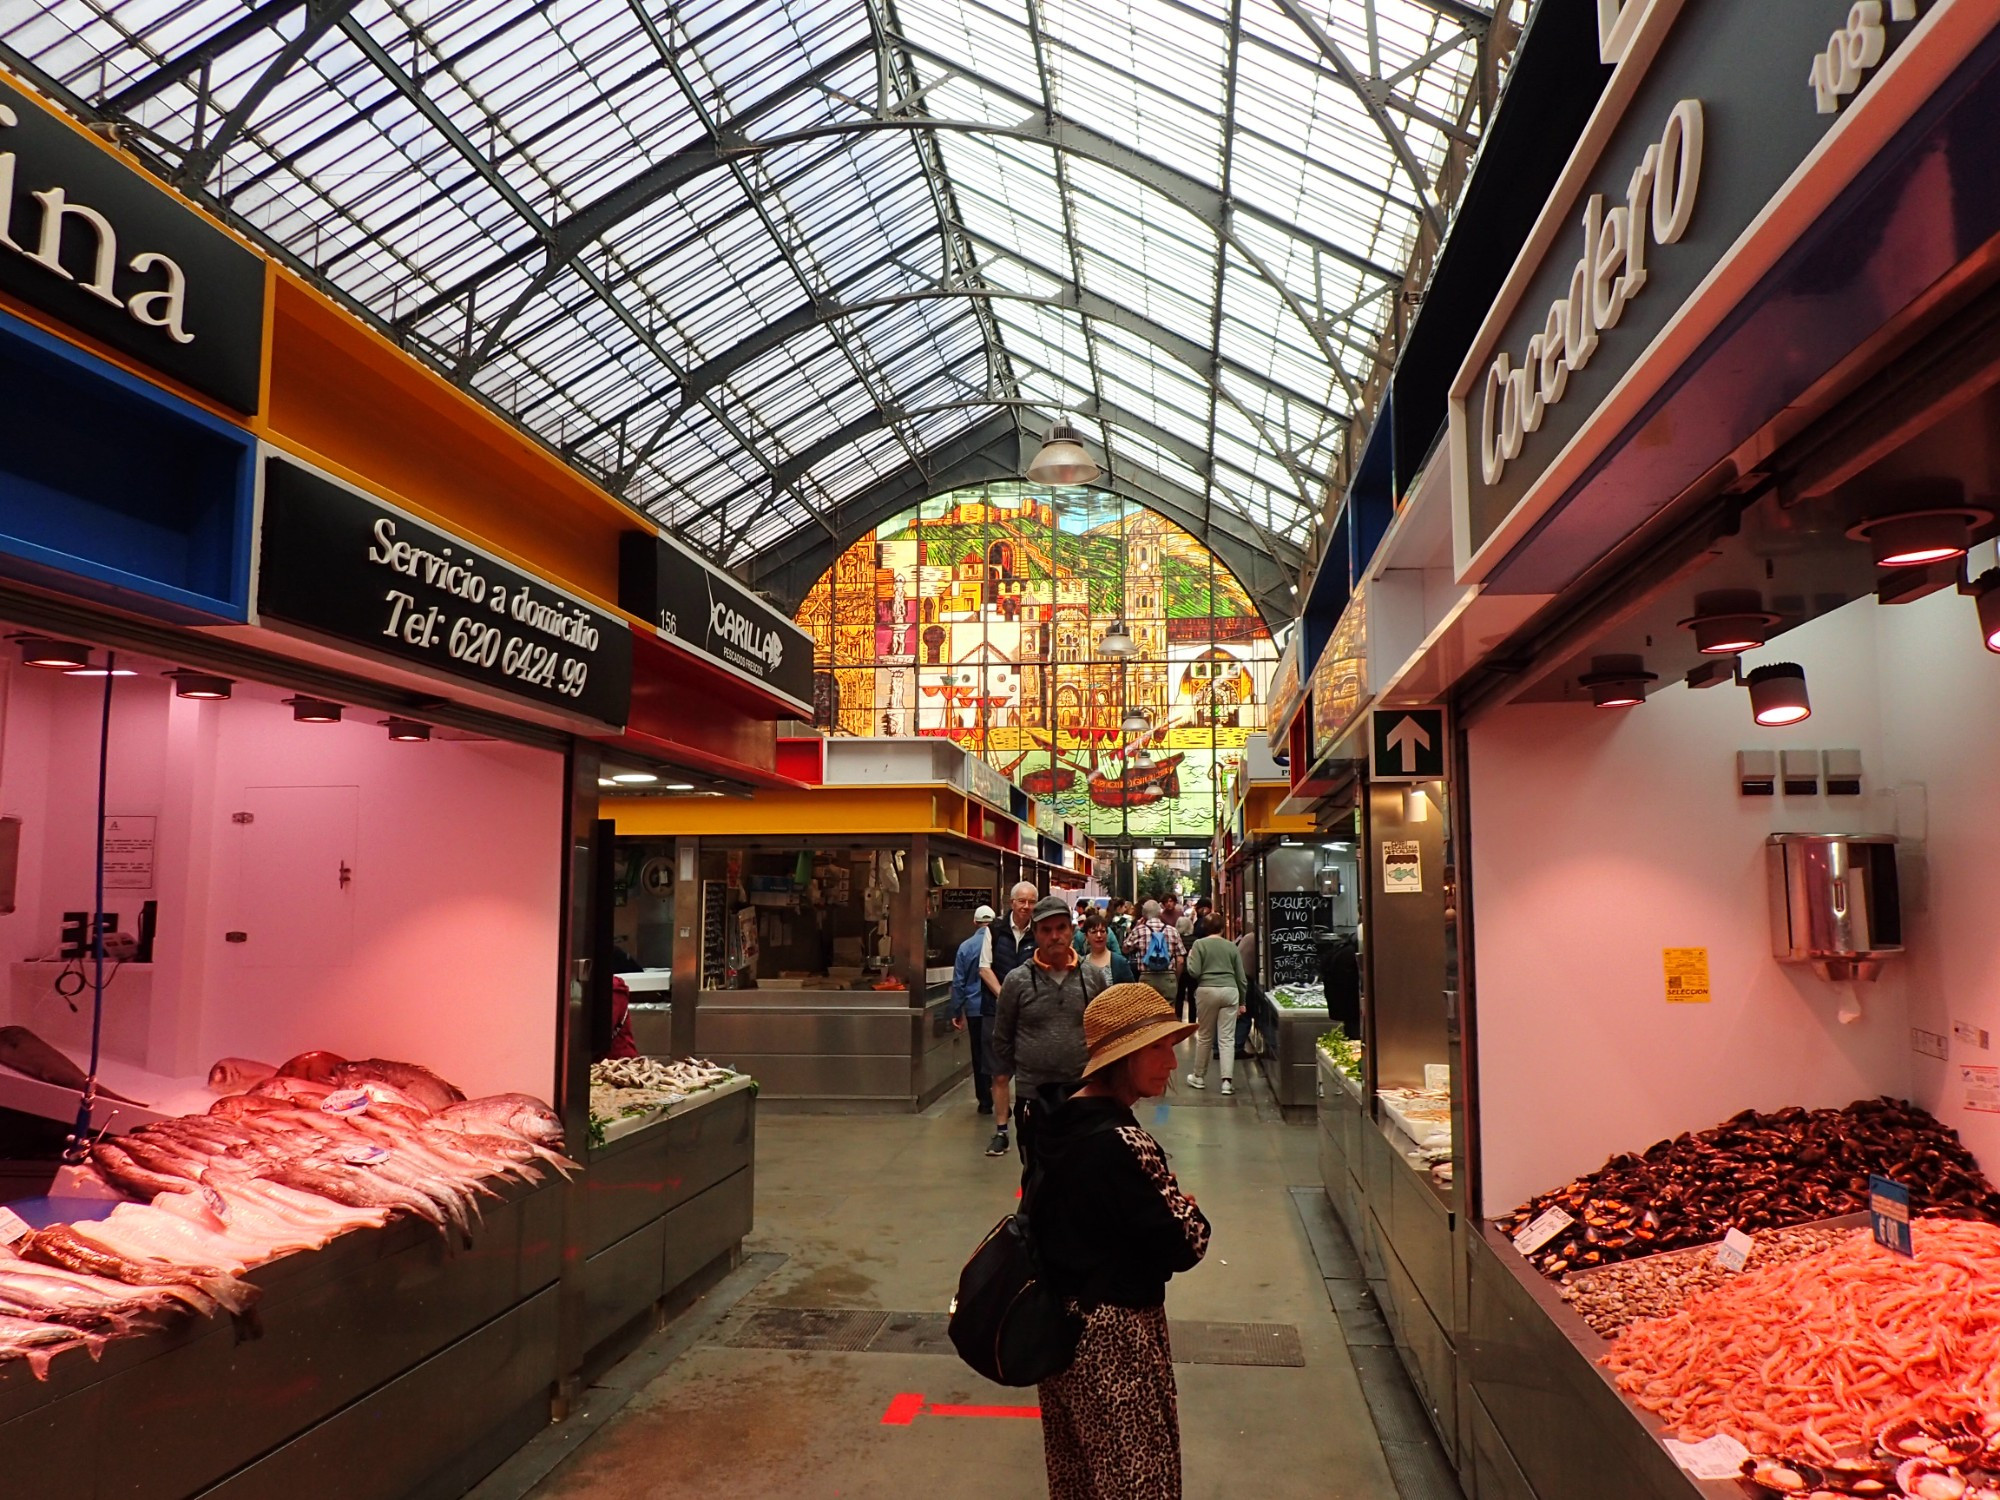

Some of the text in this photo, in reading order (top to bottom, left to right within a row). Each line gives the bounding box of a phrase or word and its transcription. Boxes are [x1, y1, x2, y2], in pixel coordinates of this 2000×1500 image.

[1482, 99, 1704, 485] Cocedero
[369, 518, 599, 651] Servicio a domicilio
[660, 608, 677, 636] 156
[383, 590, 588, 697] Tel: 620 6424 99
[723, 646, 763, 677] PESCADOS FRESCOS
[1285, 910, 1308, 922] VIVO
[1282, 943, 1317, 952] FRESCAS
